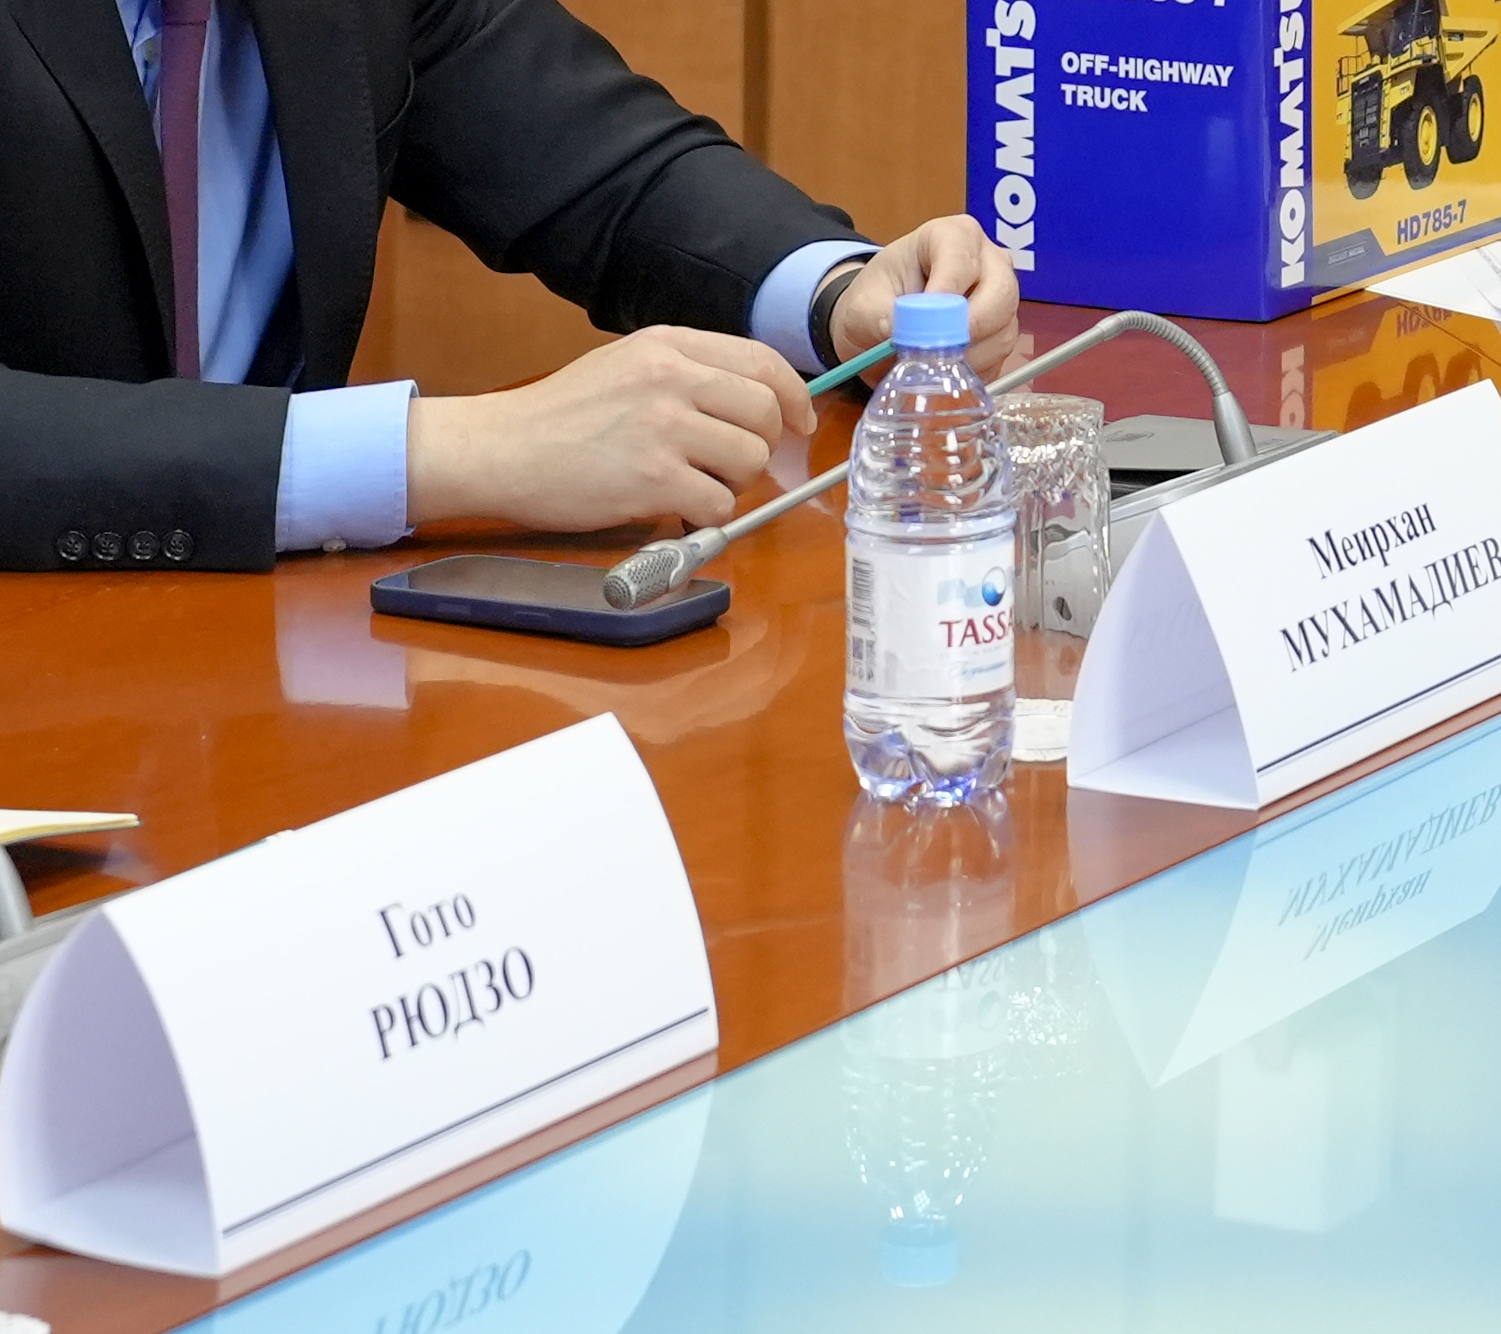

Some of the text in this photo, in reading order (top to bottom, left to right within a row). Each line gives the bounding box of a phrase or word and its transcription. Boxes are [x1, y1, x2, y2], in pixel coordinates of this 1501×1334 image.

[1060, 83, 1148, 112] TRUCK
[1061, 51, 1235, 88] OFF-HIGHWAY
[1397, 199, 1467, 246] HD785-7
[1305, 502, 1438, 580] Меирхан
[376, 892, 477, 959] Гото
[370, 945, 536, 1061] РЮДЗО
